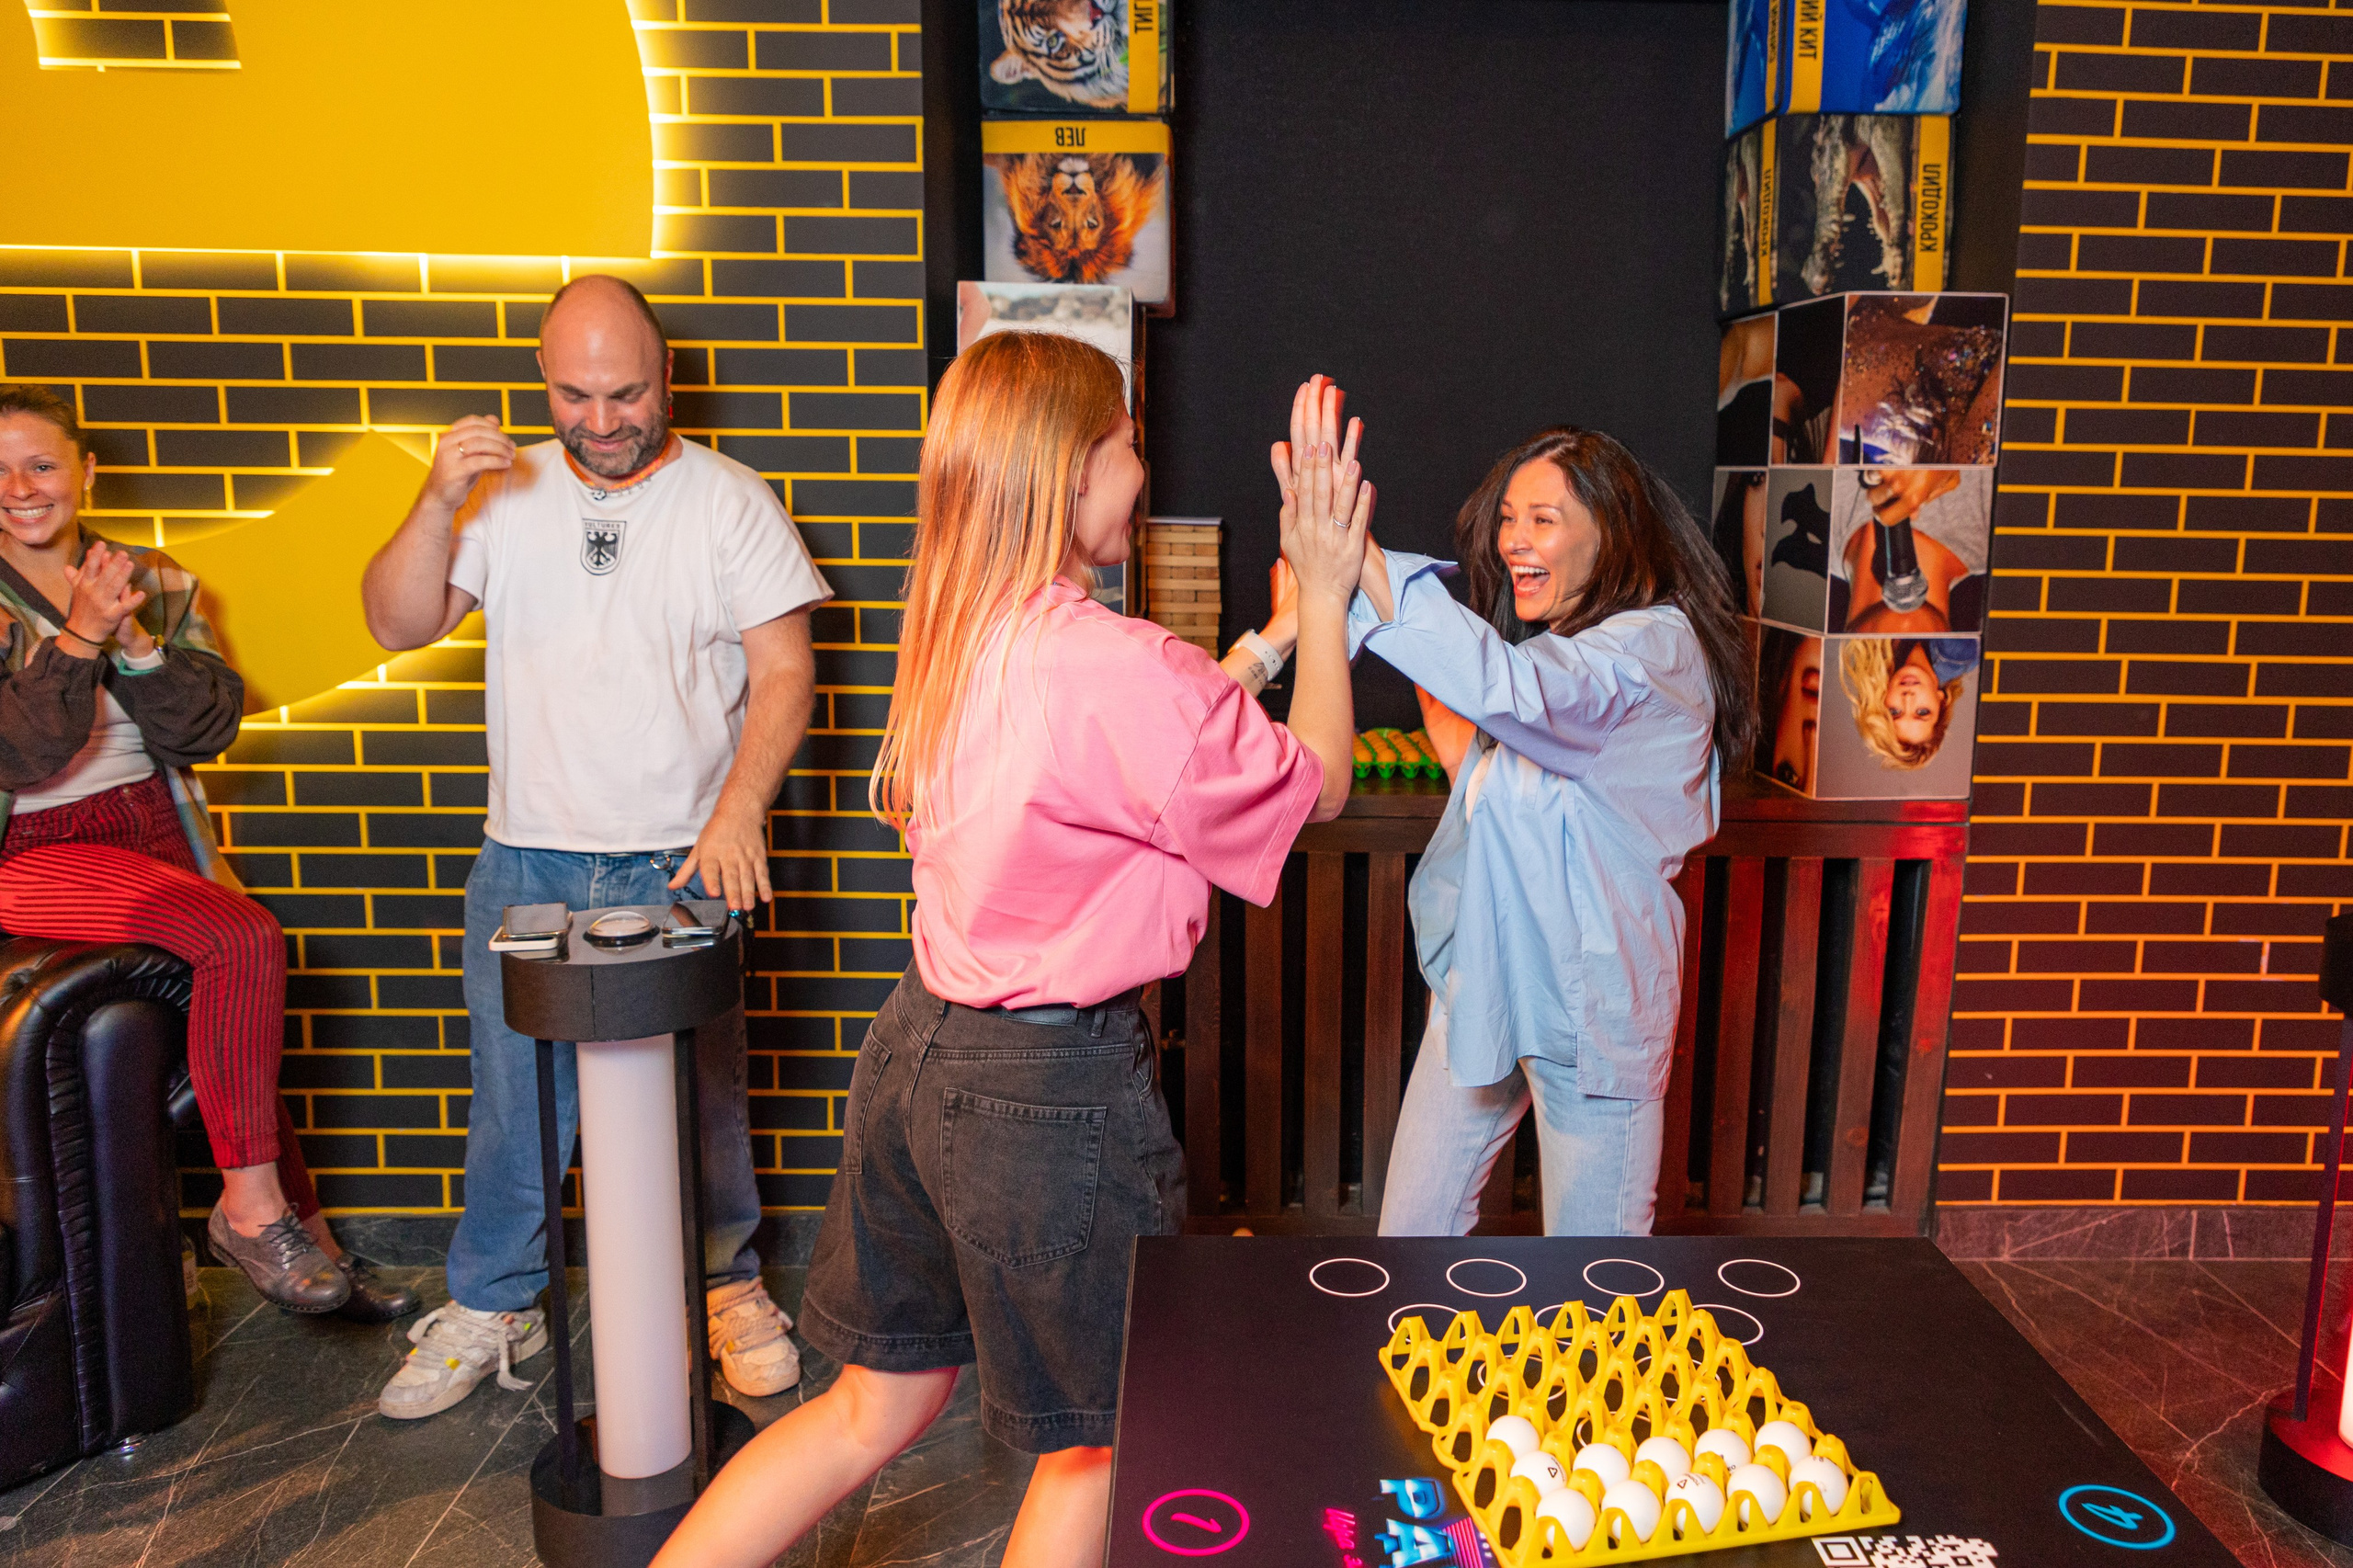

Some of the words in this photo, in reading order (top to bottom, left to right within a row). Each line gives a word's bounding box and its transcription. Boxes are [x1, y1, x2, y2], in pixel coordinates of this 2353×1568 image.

[1134, 0, 1154, 34] ТИГ
[1799, 27, 1819, 60] КИТ
[1055, 127, 1086, 147] ЛЕВ
[1919, 163, 1942, 254] КРОКОДИЛ
[2081, 1503, 2143, 1530] 4
